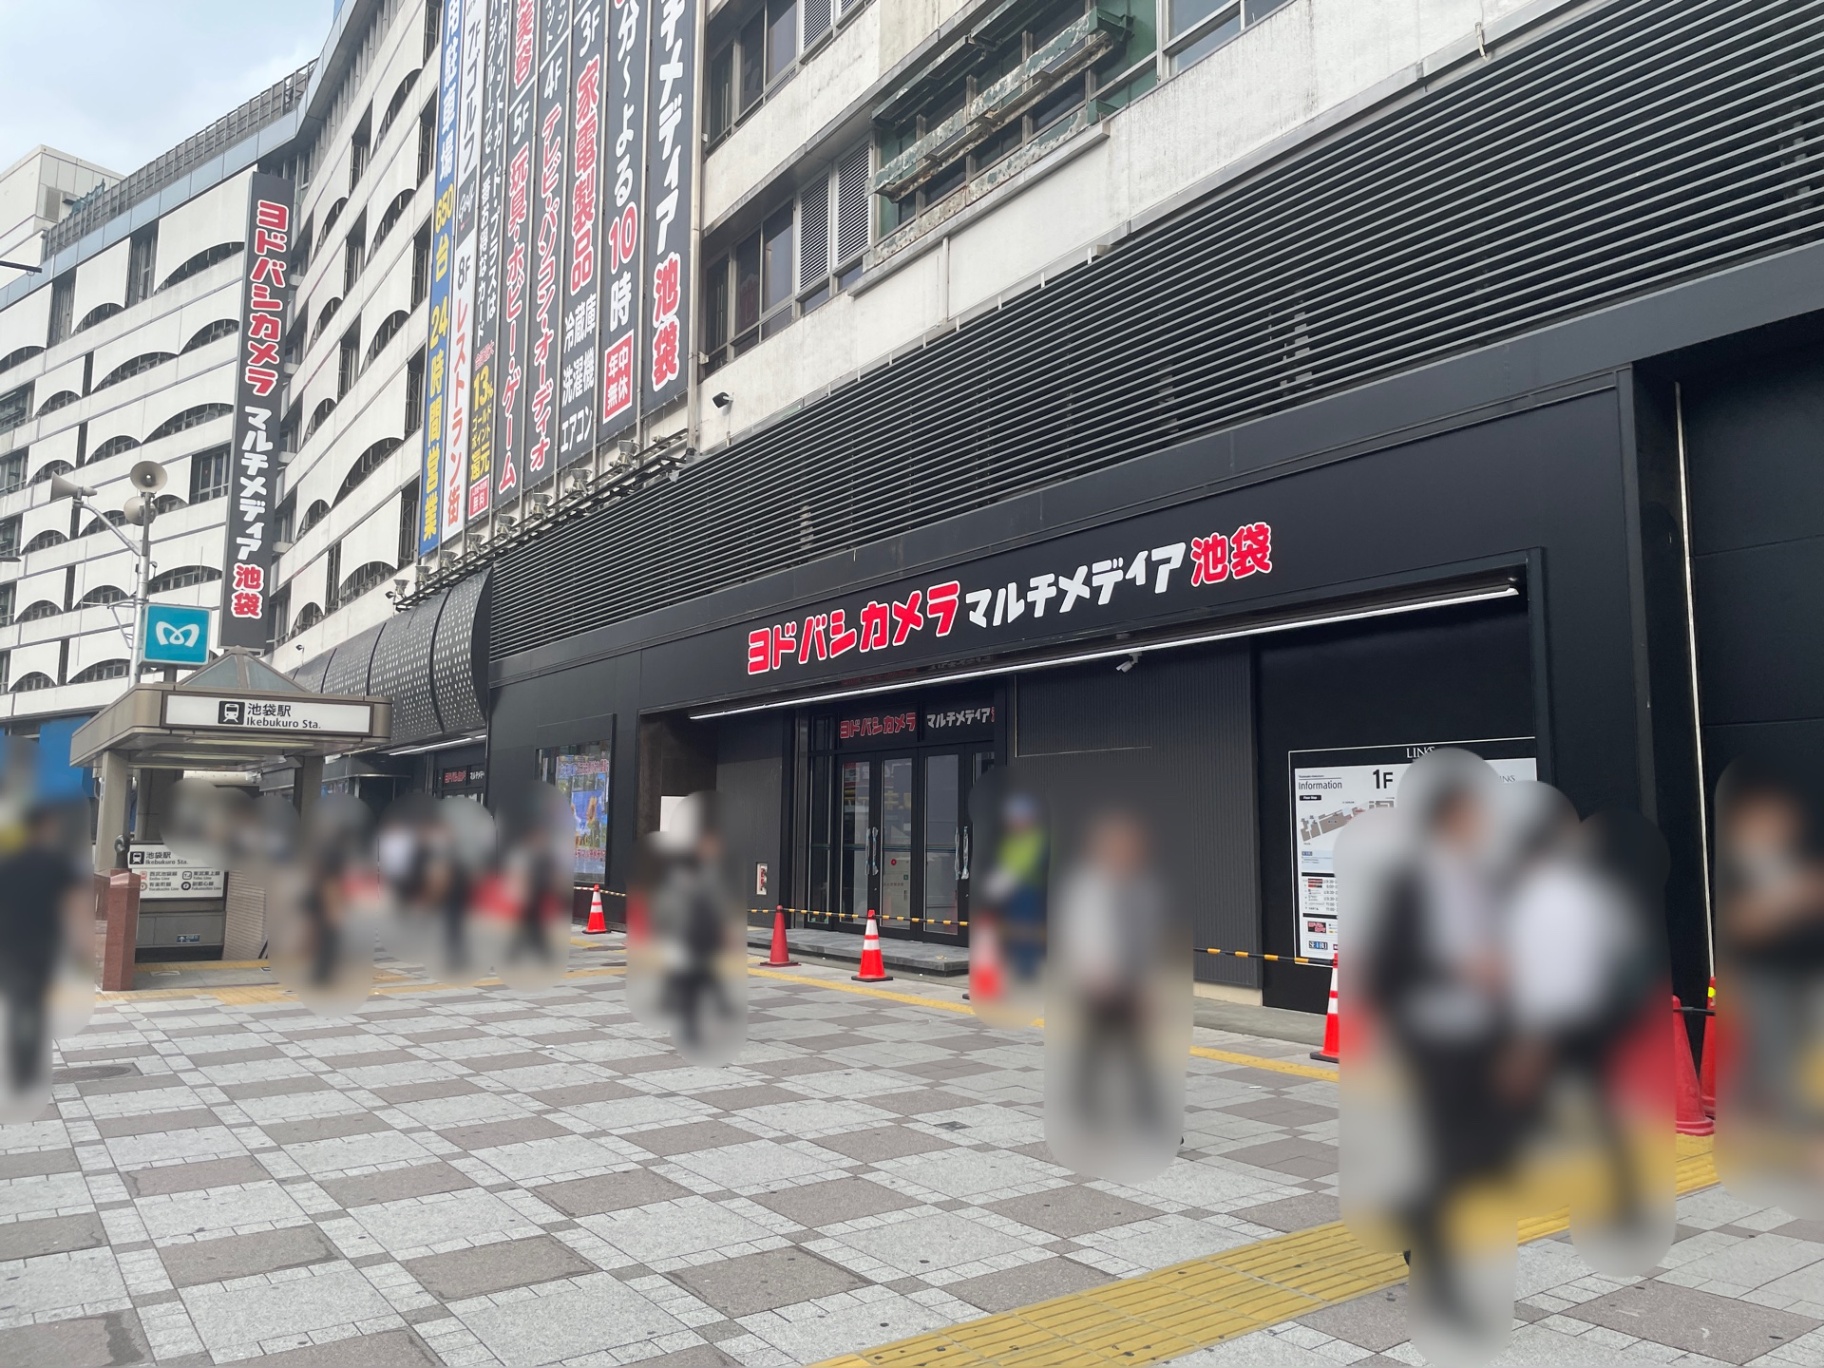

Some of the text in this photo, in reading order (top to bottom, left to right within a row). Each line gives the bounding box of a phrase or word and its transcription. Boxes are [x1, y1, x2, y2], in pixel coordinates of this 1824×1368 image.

[544, 56, 563, 99] 4F
[513, 101, 530, 145] 5F
[570, 5, 600, 296] 3F 家電製品
[245, 199, 289, 396] ヨドバシカメラ
[564, 293, 596, 354] 冷蔵庫
[562, 346, 594, 408] 洗濯機
[447, 298, 468, 526] レストラン街
[561, 405, 593, 454] エアコン
[747, 580, 961, 675] ヨドバシカメラ
[246, 716, 321, 729] Ikebukuro Sta.
[247, 703, 291, 717] 池袋駅
[840, 706, 995, 739] ヨドバシカメラ マルチメディア
[1298, 769, 1393, 790] Information 1F
[146, 851, 171, 859] 池袋駅
